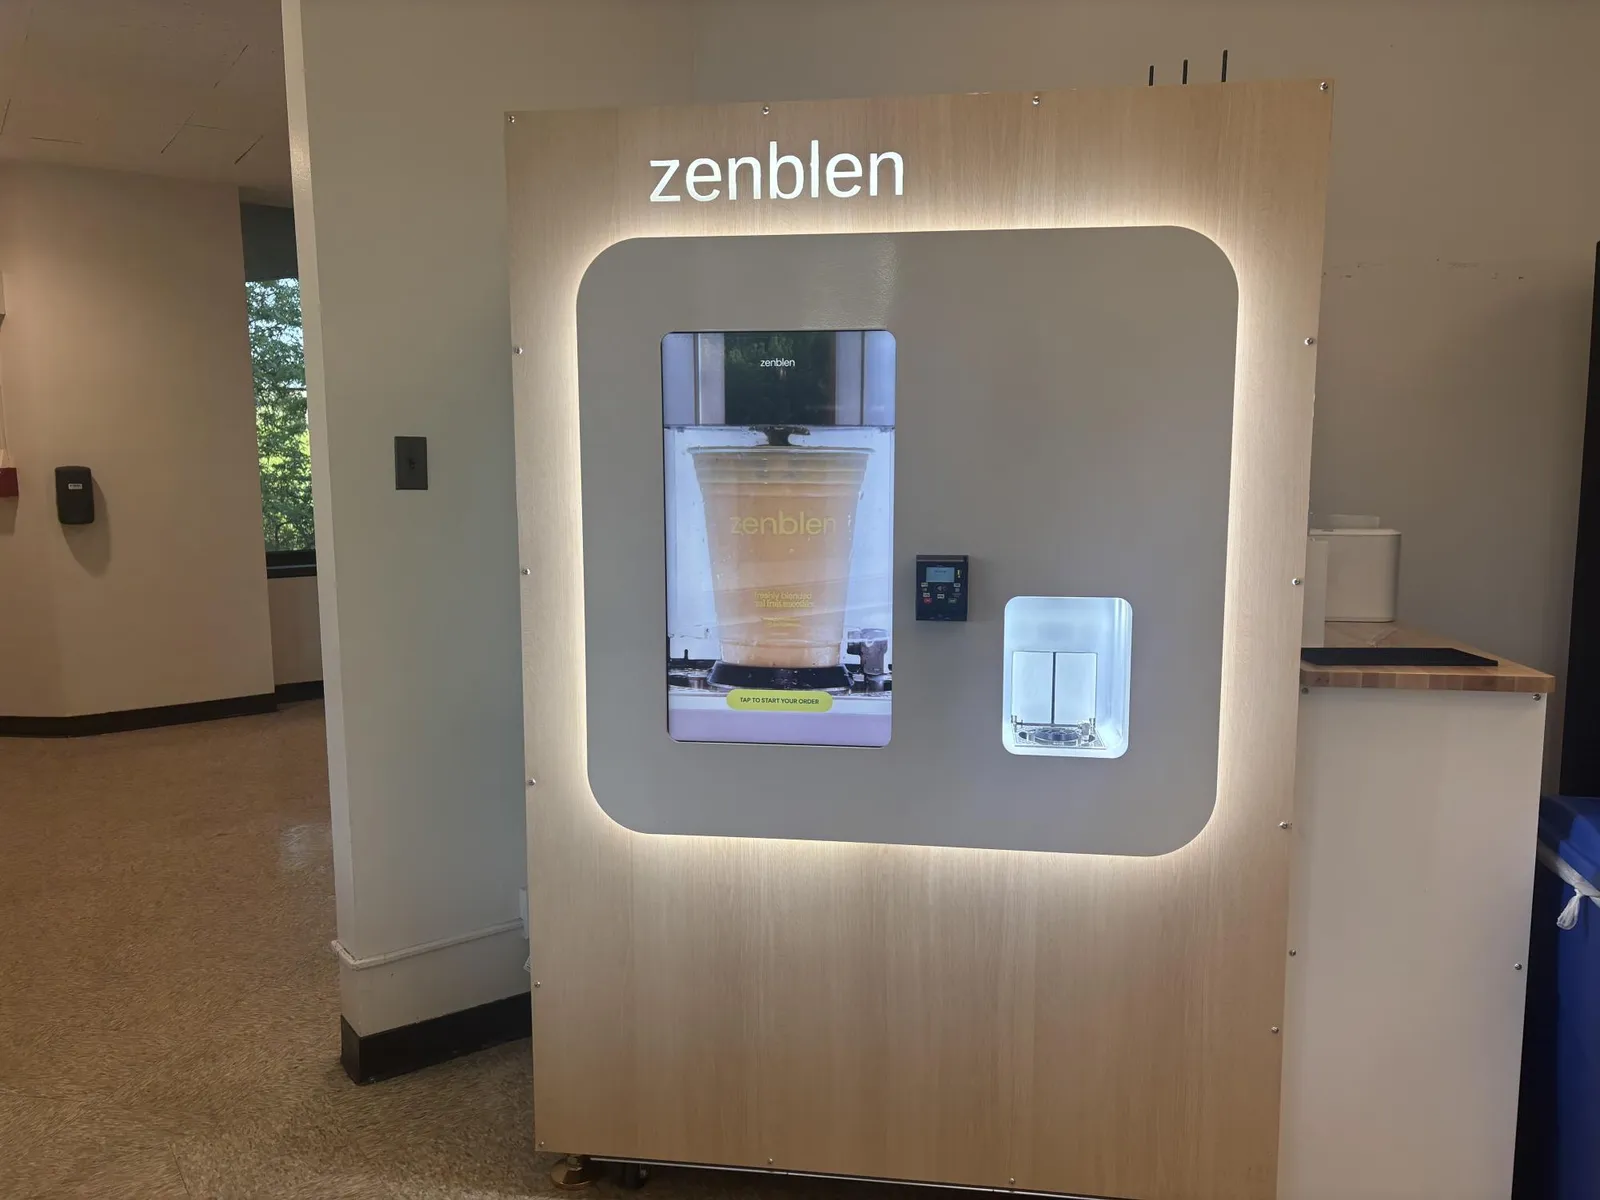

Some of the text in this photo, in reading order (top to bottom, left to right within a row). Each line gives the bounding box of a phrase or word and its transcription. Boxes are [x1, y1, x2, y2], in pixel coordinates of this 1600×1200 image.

[649, 139, 904, 202] zenblen
[760, 357, 796, 367] zenblen
[730, 510, 837, 535] zenblen
